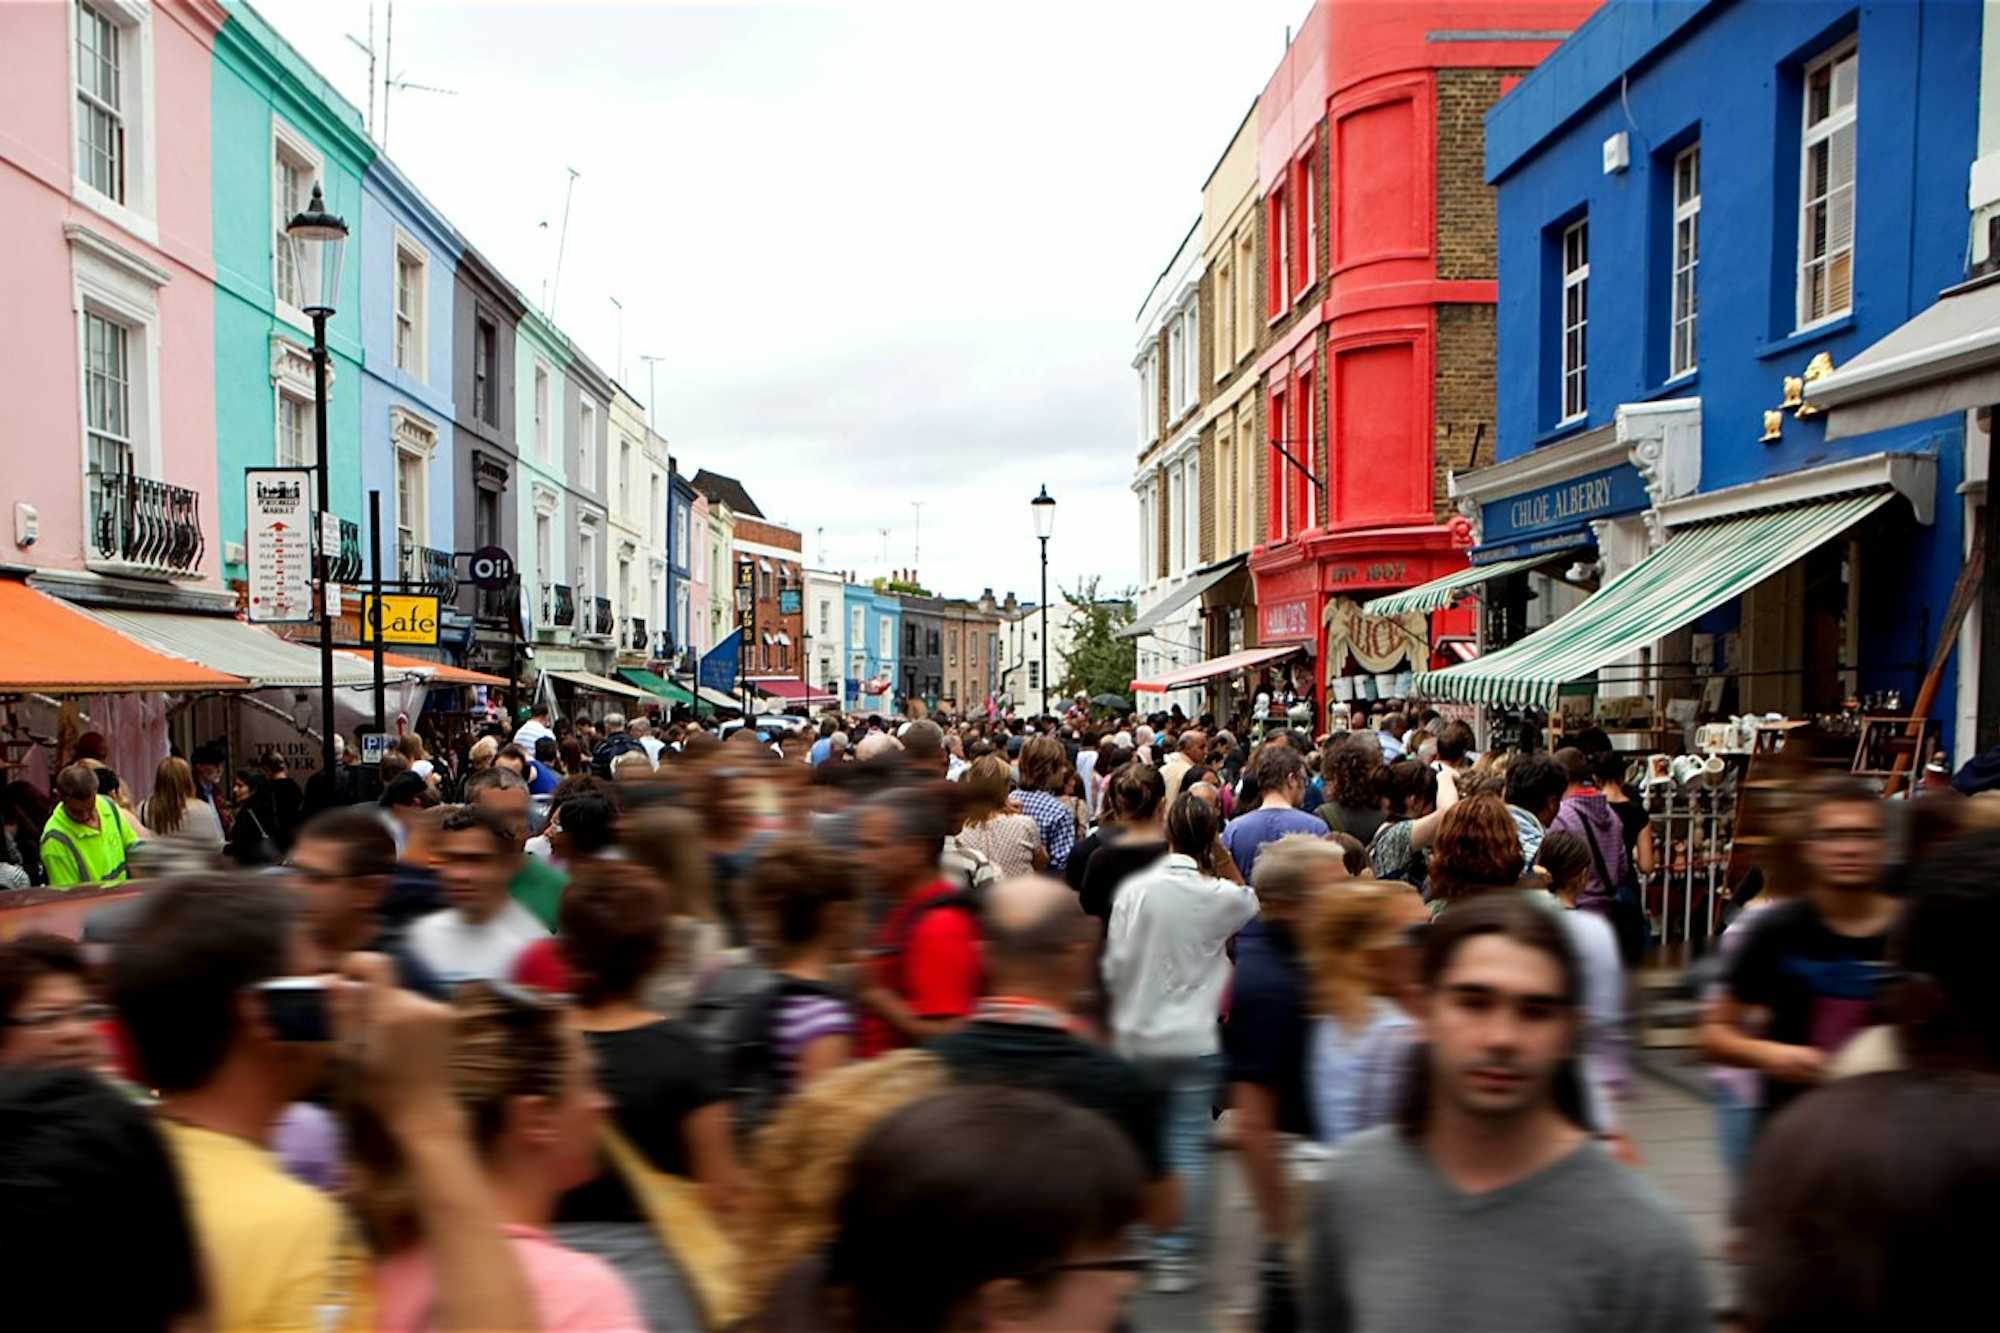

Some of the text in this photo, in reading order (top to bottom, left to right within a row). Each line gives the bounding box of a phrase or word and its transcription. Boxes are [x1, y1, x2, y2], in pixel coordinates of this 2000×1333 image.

[262, 506, 295, 514] MARKET
[1511, 476, 1612, 528] CHLOE ALBERRY
[475, 559, 509, 578] Oi!
[254, 742, 310, 756] TRUDE
